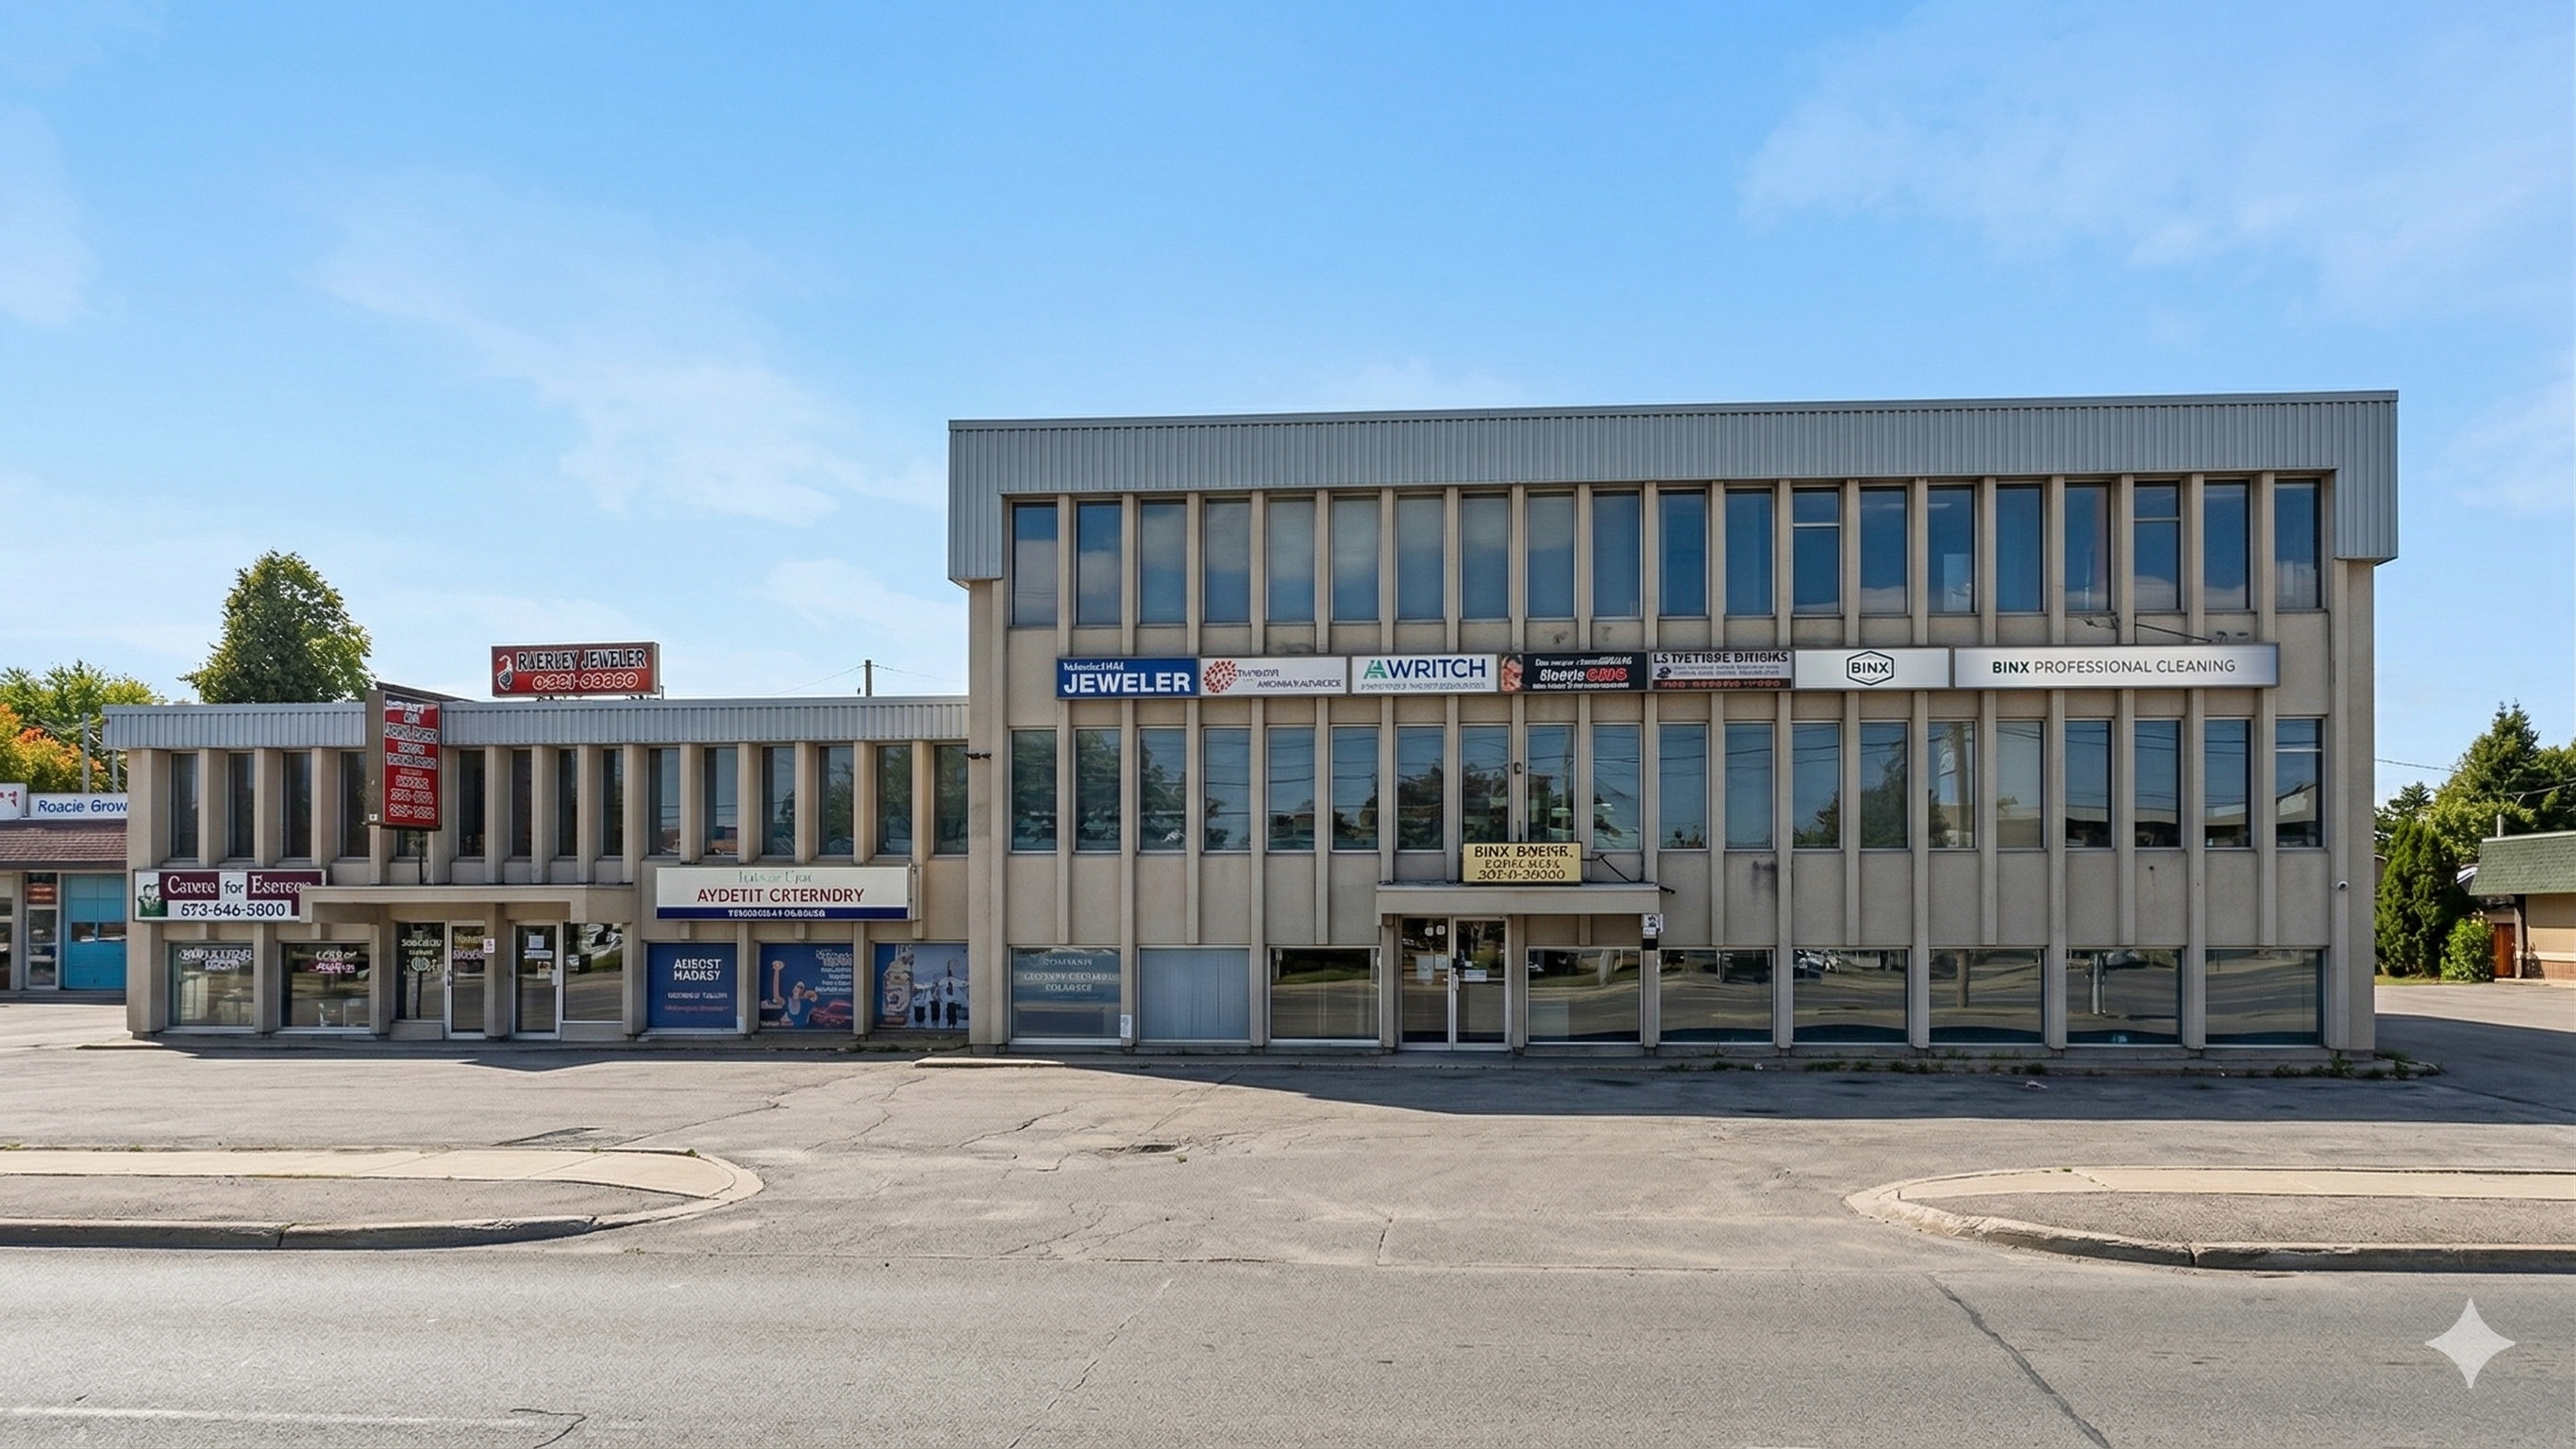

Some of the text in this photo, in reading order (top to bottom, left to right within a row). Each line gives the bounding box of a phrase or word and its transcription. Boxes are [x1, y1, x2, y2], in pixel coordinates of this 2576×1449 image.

[1851, 661, 1889, 675] BINX
[1992, 659, 2235, 674] BINX PROFESSIONAL CLEANING
[1063, 673, 1191, 693] JEWELER
[38, 799, 85, 812] Roacie
[1474, 846, 1510, 858] BINX
[225, 880, 243, 894] for
[696, 888, 864, 903] AYDETIT CRTERNDRY
